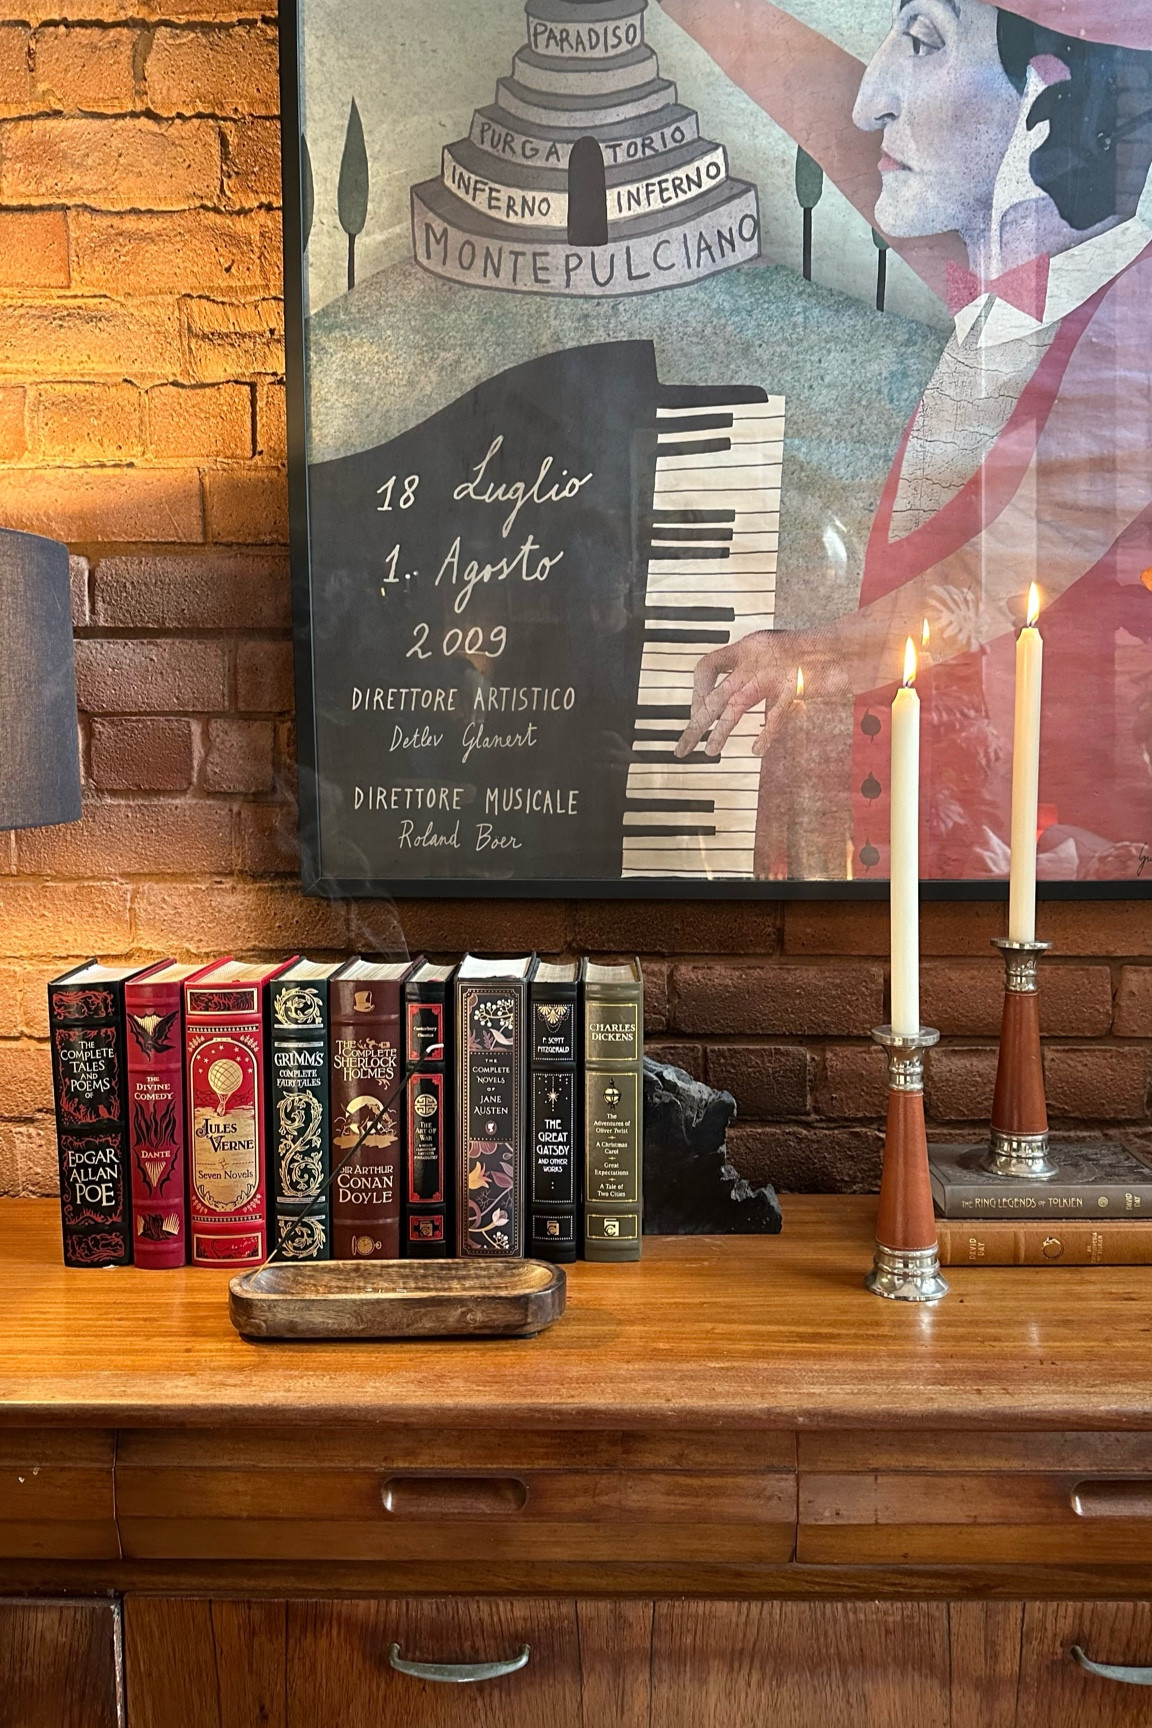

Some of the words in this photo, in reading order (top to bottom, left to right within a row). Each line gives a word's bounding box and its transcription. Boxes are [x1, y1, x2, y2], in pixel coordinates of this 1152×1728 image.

[532, 22, 638, 53] PARADISO
[450, 164, 552, 218] INFERNO
[615, 160, 721, 214] INFERNO
[423, 213, 758, 289] MONTEPULCIANO
[376, 474, 420, 512] 18
[453, 434, 593, 538] Luglio
[434, 534, 564, 614] Agosto
[405, 622, 507, 659] 2009
[351, 686, 458, 712] DIRETTORE
[473, 686, 576, 712] ARTISTICO
[389, 724, 443, 752] Detlev
[461, 722, 538, 764] Glanert
[354, 786, 465, 811] DIRETTORE
[485, 787, 580, 816] MUSICALE
[398, 819, 461, 849] Roland
[589, 1023, 636, 1033] CHARLES
[591, 1032, 634, 1042] DICKENS
[78, 1040, 96, 1050] THE
[335, 1039, 357, 1056] THE
[60, 1047, 115, 1061] COMPLETE
[342, 1048, 398, 1058] COMPLETE
[69, 1059, 106, 1074] TALES
[333, 1054, 398, 1070] SHERLOCK
[80, 1072, 99, 1081] AND
[279, 1069, 318, 1078] COMPLETE
[343, 1067, 395, 1082] HOLMES
[472, 1066, 511, 1074] COMPLETE
[70, 1077, 111, 1093] POEMS
[136, 1082, 171, 1091] DIVINE
[476, 1075, 506, 1085] NOVELS
[84, 1091, 95, 1099] OF
[134, 1091, 174, 1101] COMEDY
[479, 1095, 502, 1105] JANE
[473, 1105, 509, 1116] AUSTEN
[195, 1118, 238, 1138] JULES
[543, 1119, 562, 1130] THE
[206, 1134, 255, 1153] VERNE
[537, 1131, 569, 1143] GREAT
[141, 1150, 171, 1159] DANTE
[536, 1144, 570, 1156] GATSBY
[68, 1148, 120, 1168] EDGAR
[549, 1158, 568, 1166] OTHER
[603, 1161, 620, 1169] Great
[69, 1164, 118, 1184] ALLAN
[198, 1170, 222, 1180] Seven
[223, 1169, 254, 1180] Novels
[353, 1164, 394, 1175] ARTHUR
[542, 1165, 563, 1173] WORKS
[336, 1173, 394, 1190] CONAN
[75, 1182, 116, 1207] POE
[338, 1187, 393, 1205] DOYLE
[597, 1190, 610, 1198] Two
[961, 1200, 973, 1209] THE
[974, 1197, 997, 1209] RING
[997, 1197, 1037, 1209] LEGENDS
[1037, 1200, 1047, 1208] OF
[1048, 1197, 1083, 1209] TOLKIEN
[968, 1237, 977, 1261] DAVID
[977, 1241, 986, 1257] DAY
